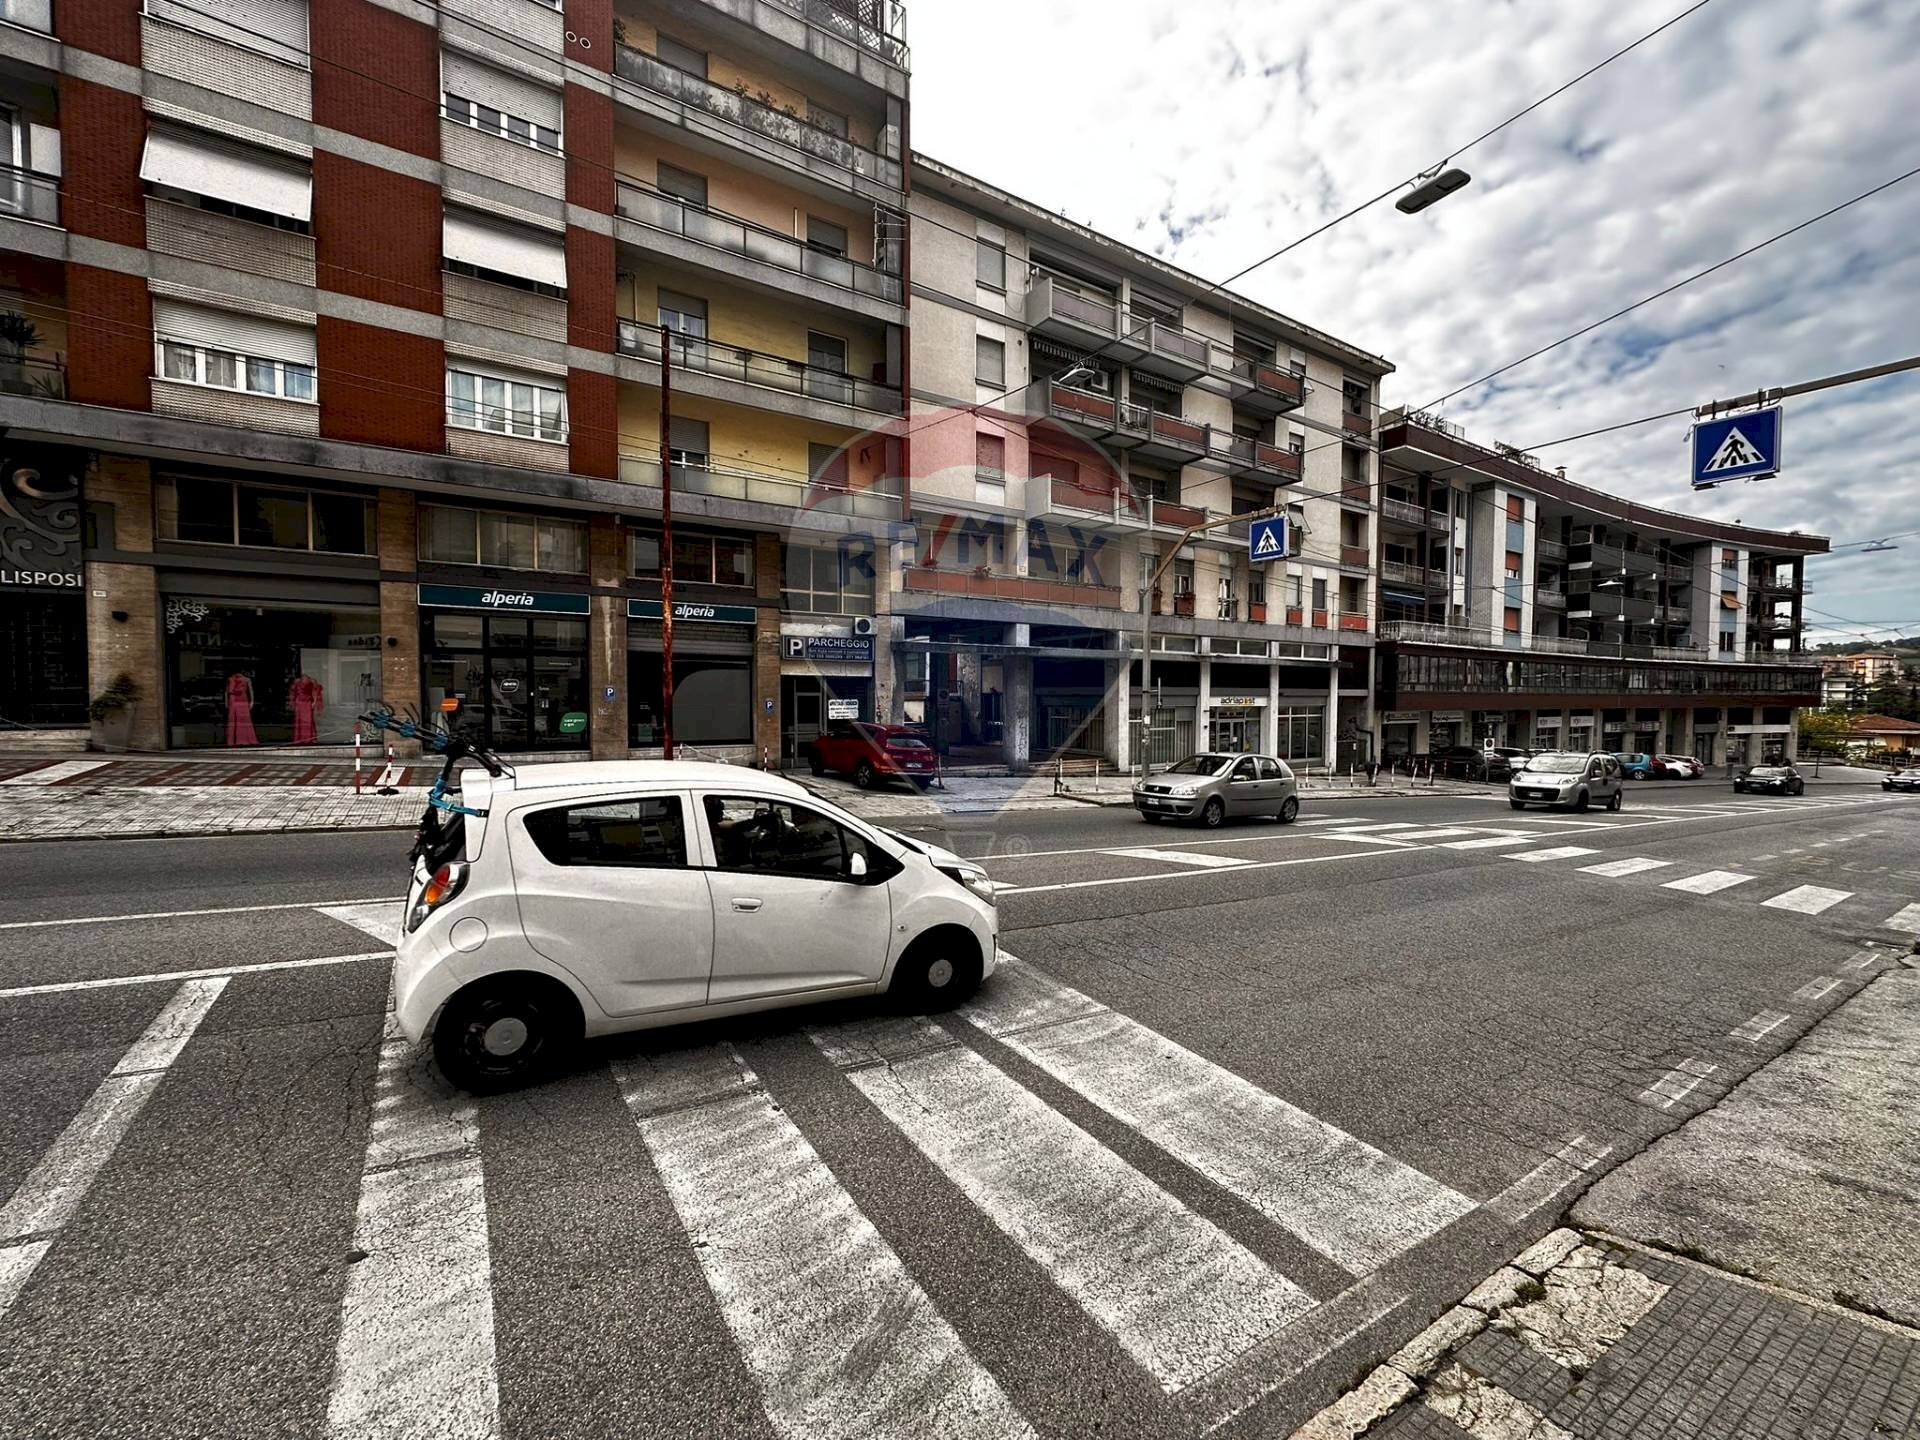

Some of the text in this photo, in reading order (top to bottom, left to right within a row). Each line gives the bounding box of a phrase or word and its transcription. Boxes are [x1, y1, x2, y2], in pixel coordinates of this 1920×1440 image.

[1, 569, 83, 587] LISPOSI
[481, 590, 534, 607] alperia
[674, 604, 715, 619] alperia
[790, 638, 803, 656] P
[808, 637, 870, 649] PARCHEGGIO
[607, 687, 614, 696] P
